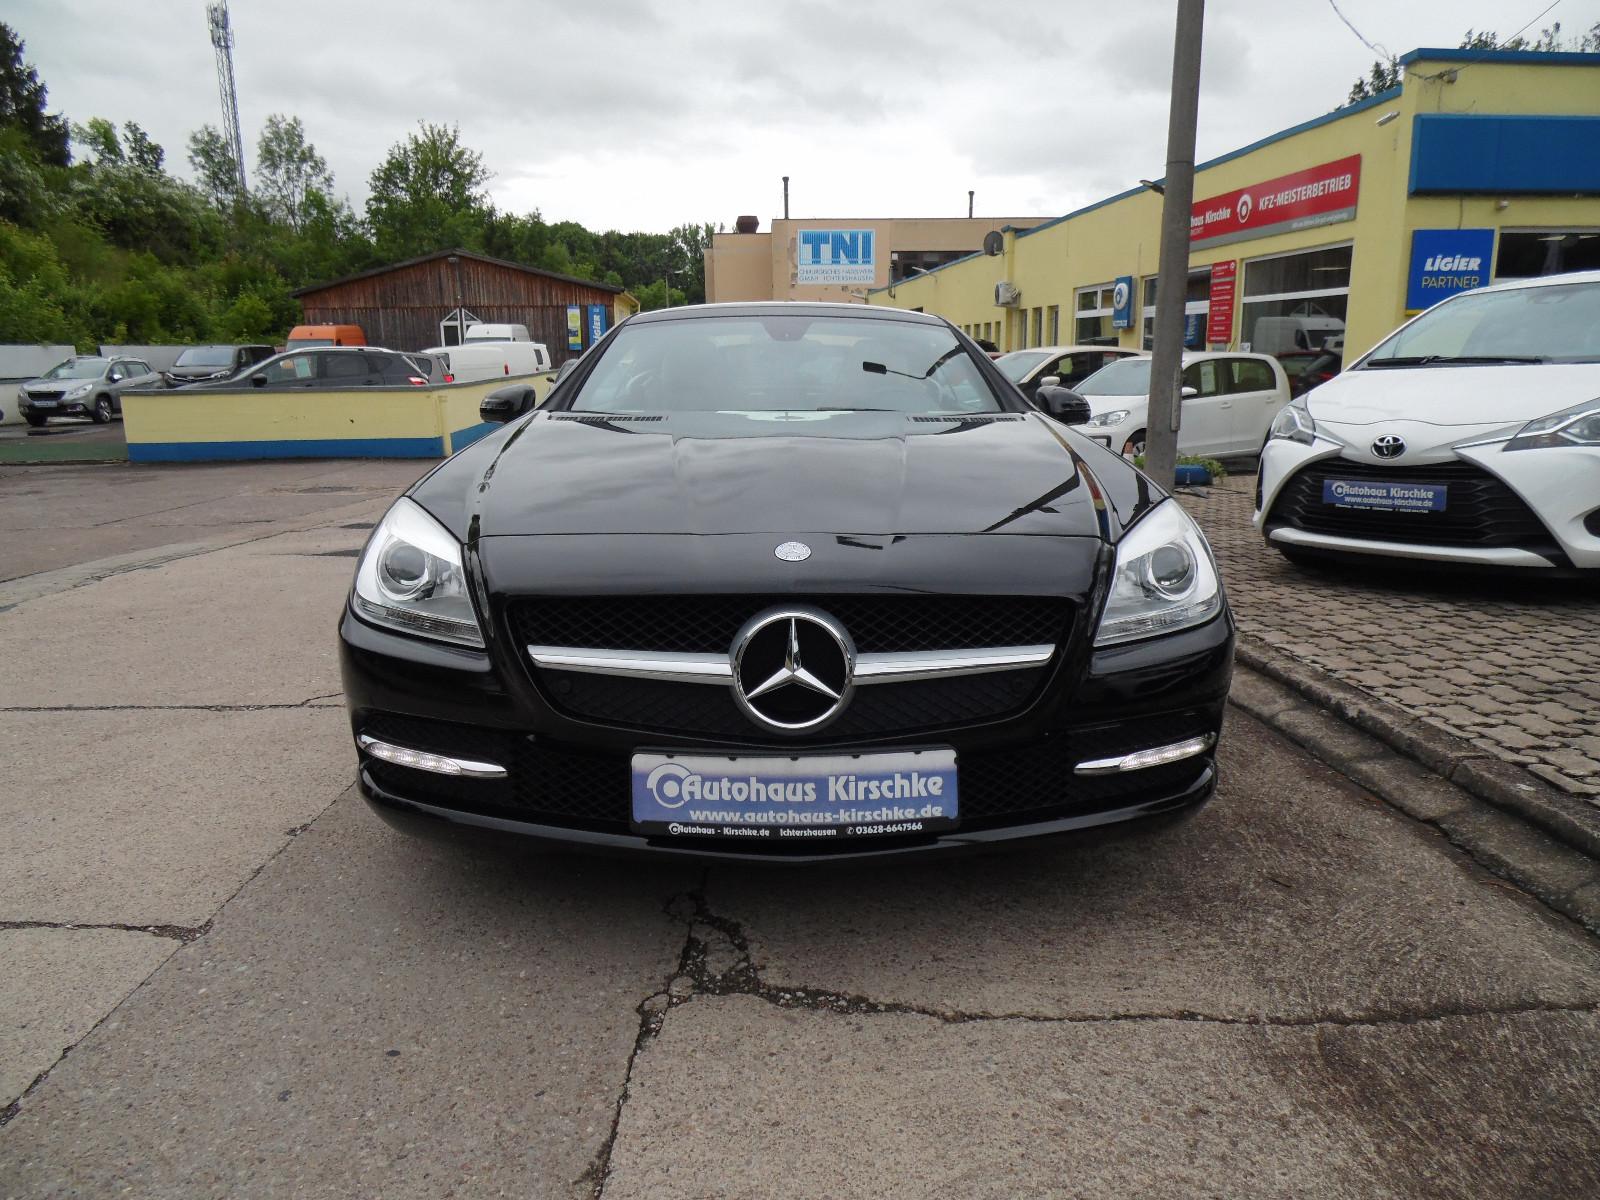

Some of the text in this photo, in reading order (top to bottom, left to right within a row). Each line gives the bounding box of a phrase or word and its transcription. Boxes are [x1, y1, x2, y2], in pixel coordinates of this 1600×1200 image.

[1259, 174, 1352, 211] KFZ-MEISTERBETRIEB
[1190, 206, 1231, 228] haus Kirschke
[802, 231, 872, 265] TNI
[1424, 254, 1482, 271] LIGIER
[1421, 276, 1480, 289] PARTNER
[1343, 485, 1434, 499] Autohaus Kirschke
[1344, 496, 1433, 508] www.autohaus-kirschke.de
[682, 771, 943, 802] Autohaus Kirschke
[689, 803, 943, 823] www.autohaus-kirschke.de
[678, 825, 716, 835] Autohaus
[723, 826, 770, 837] Kirschke.de
[780, 828, 837, 838] Ichtershausen
[856, 822, 923, 835] 03628-6647566
